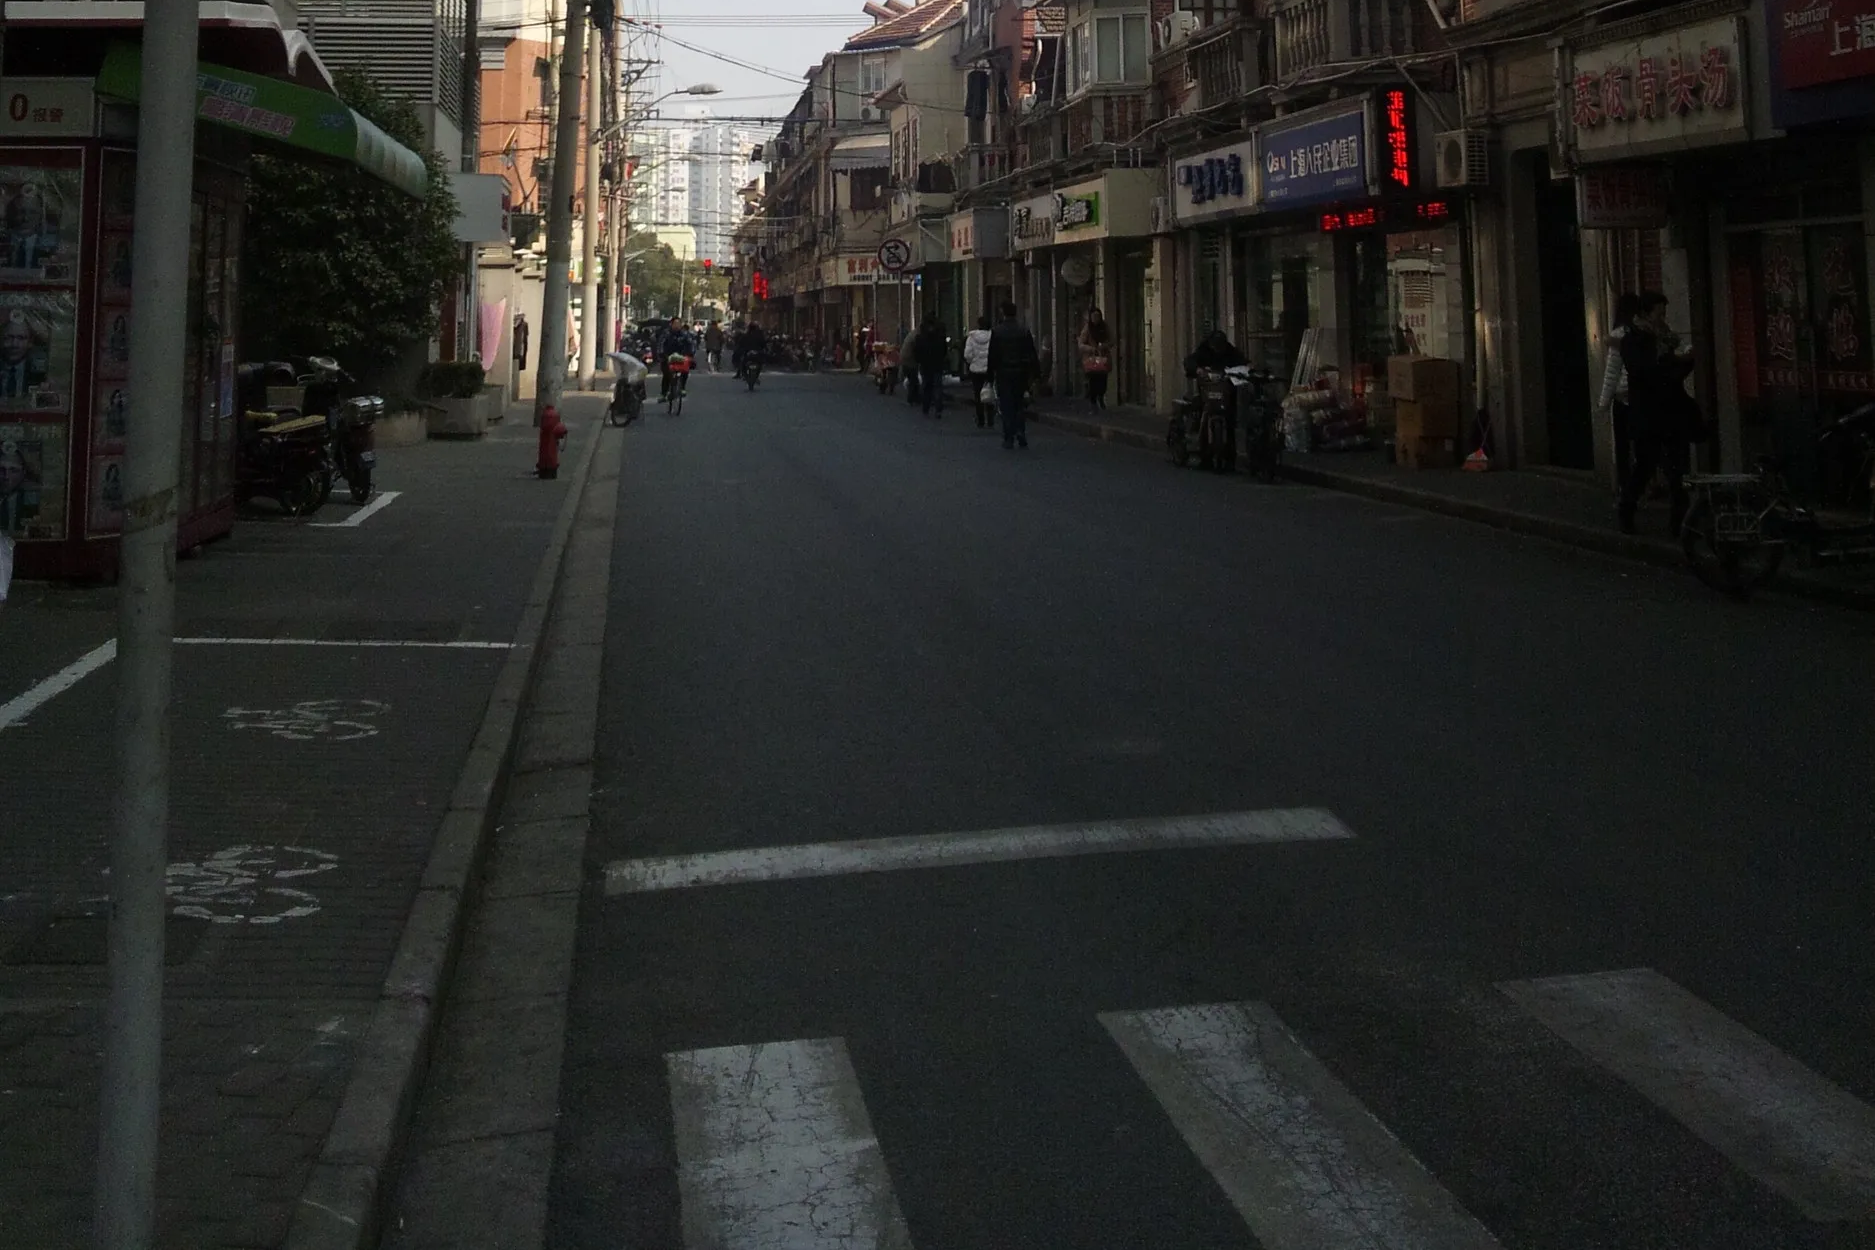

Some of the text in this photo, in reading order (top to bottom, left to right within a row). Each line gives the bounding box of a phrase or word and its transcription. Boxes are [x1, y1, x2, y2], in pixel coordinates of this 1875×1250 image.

[1573, 47, 1729, 128] 菜饭骨头汤
[1289, 135, 1358, 179] 上海人民企业集团
